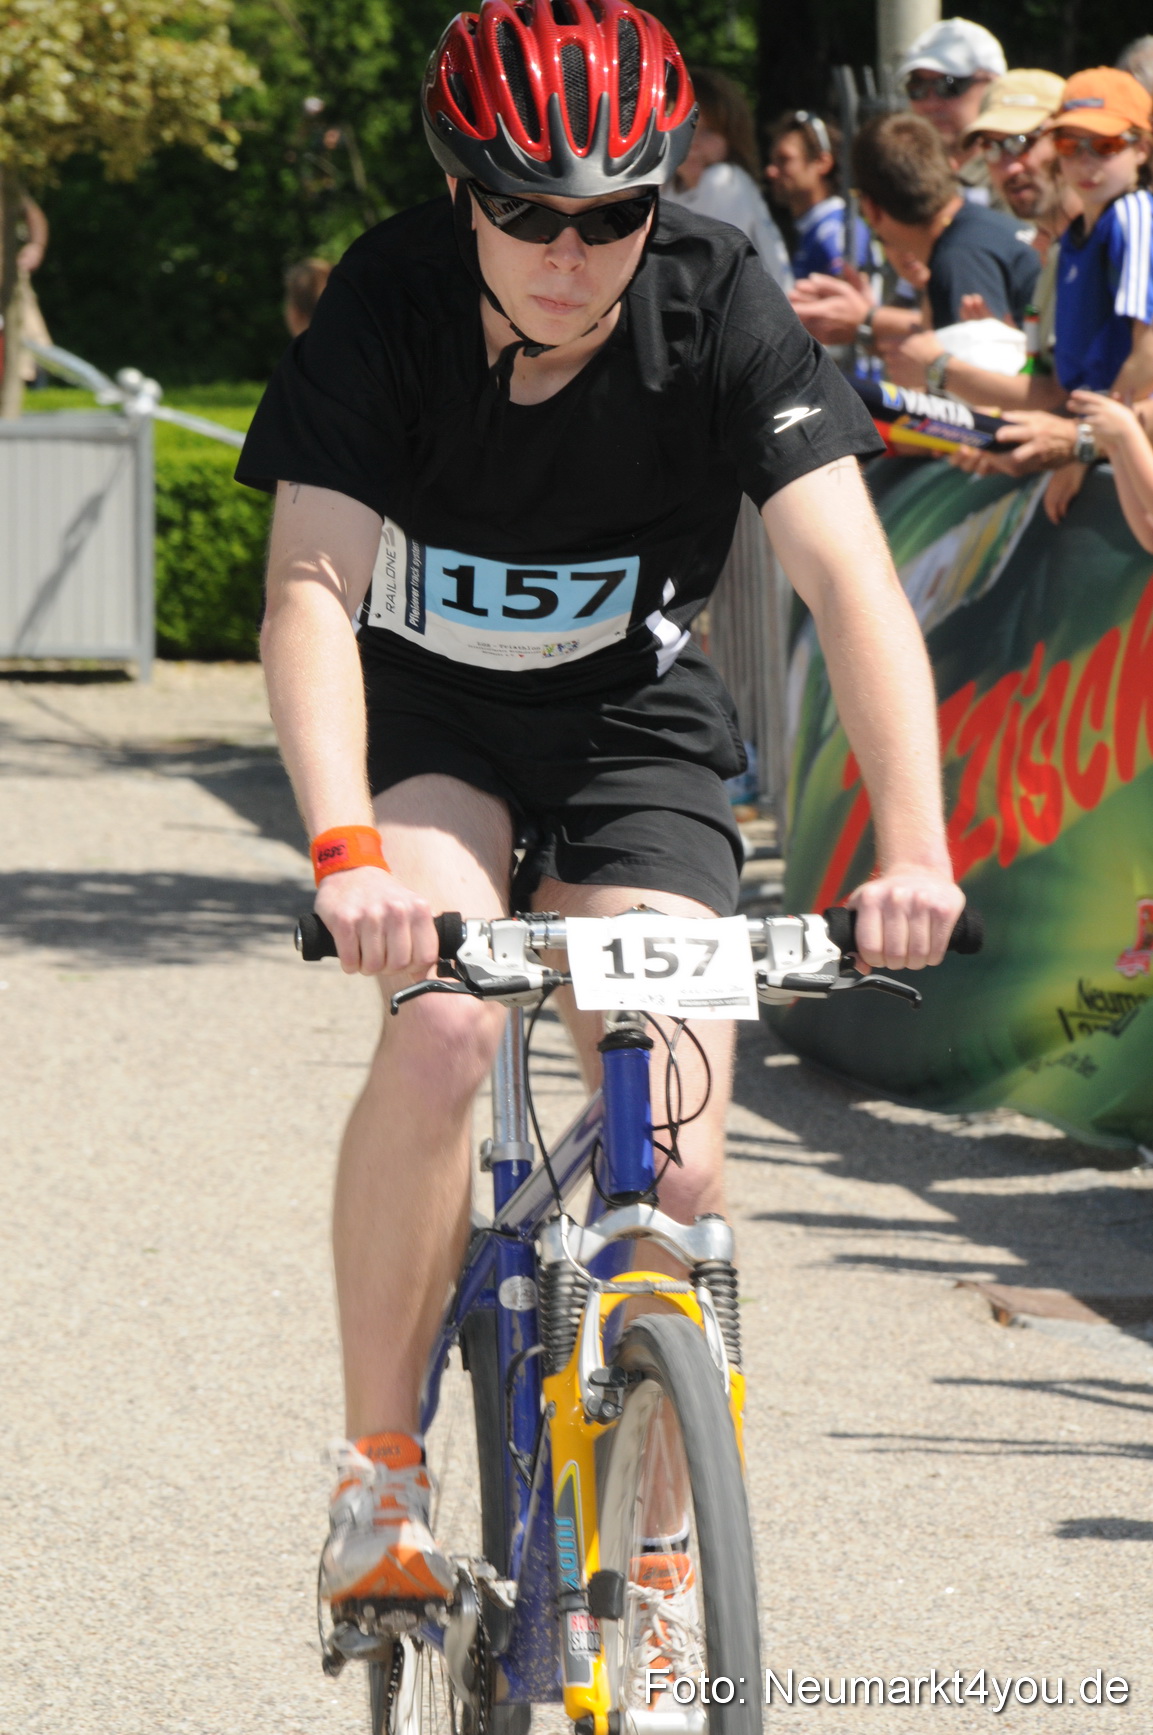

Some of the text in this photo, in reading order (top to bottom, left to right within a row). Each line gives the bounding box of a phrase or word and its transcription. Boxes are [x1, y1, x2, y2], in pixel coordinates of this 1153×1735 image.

[410, 567, 421, 588] track
[441, 564, 627, 619] 157
[602, 937, 719, 979] 157
[554, 1516, 580, 1591] JUDY
